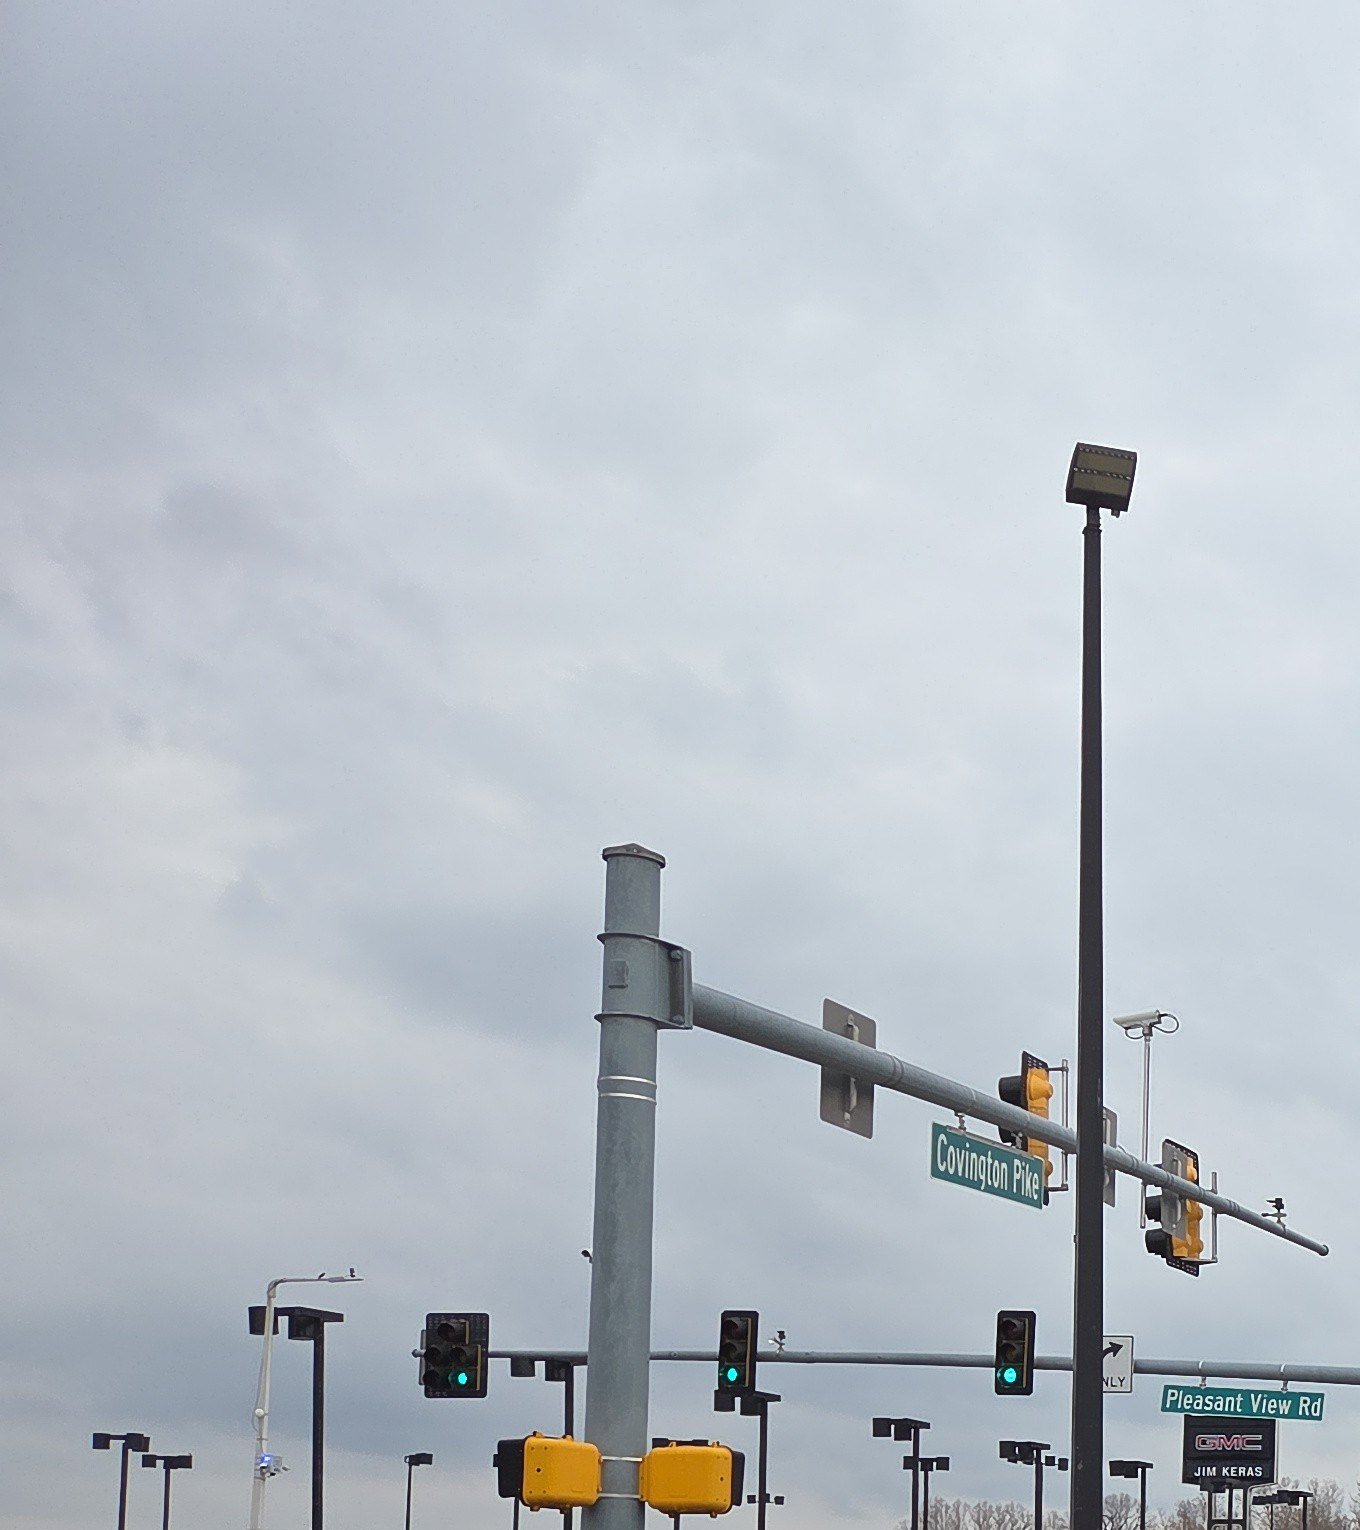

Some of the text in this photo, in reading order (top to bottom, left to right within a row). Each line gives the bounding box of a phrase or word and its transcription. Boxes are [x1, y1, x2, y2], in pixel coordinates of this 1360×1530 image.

[937, 1133, 1040, 1200] Covington Pike
[1103, 1376, 1126, 1388] NLY
[1165, 1389, 1321, 1417] Pleasant View Rd
[1195, 1434, 1262, 1451] GMC
[1193, 1466, 1263, 1477] JIM KERAS
